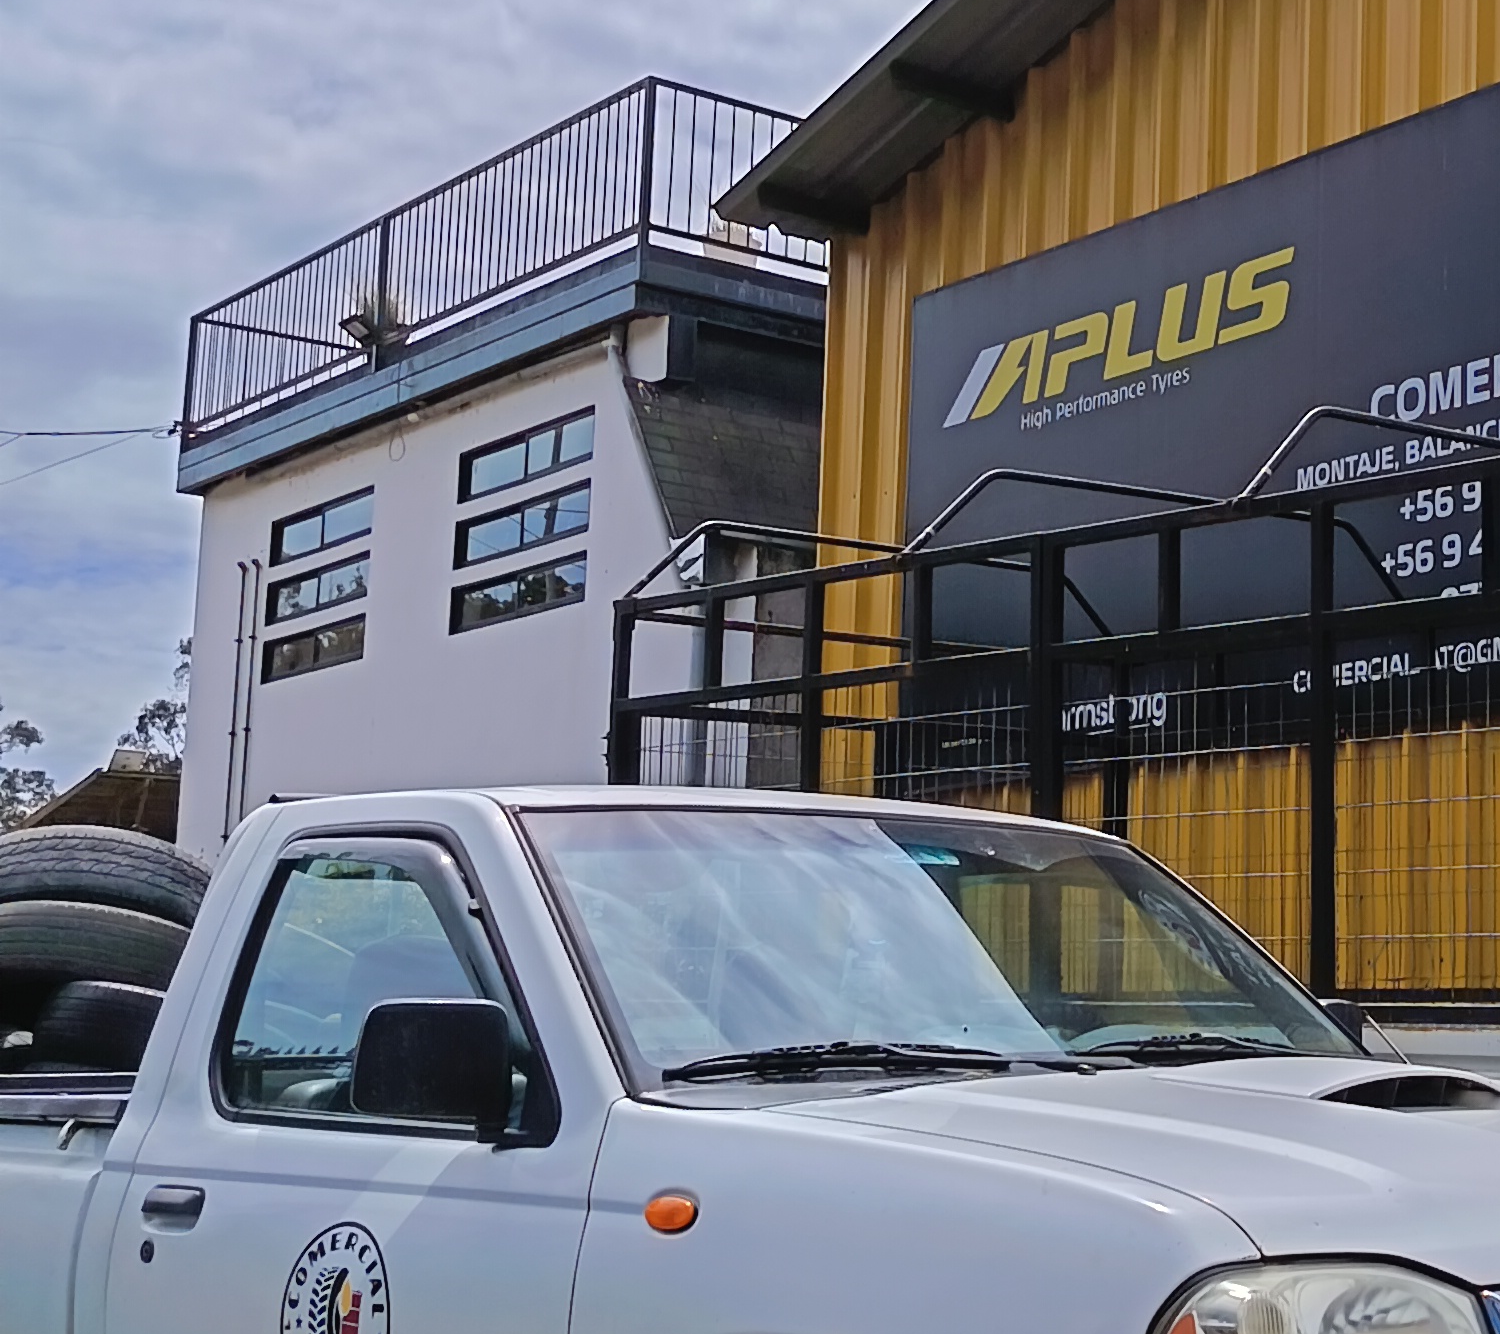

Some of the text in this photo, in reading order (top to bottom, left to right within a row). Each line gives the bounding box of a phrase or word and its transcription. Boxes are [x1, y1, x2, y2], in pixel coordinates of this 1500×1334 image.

[942, 246, 1295, 428] APLUS
[1020, 368, 1190, 431] High Performance Tyres
[1296, 446, 1399, 490] MONTAJE,
[1400, 486, 1454, 521] +56
[1462, 481, 1482, 512] 9
[1381, 539, 1434, 577] +56
[1442, 534, 1462, 568] 9
[288, 1231, 385, 1319] COMERCIAL
